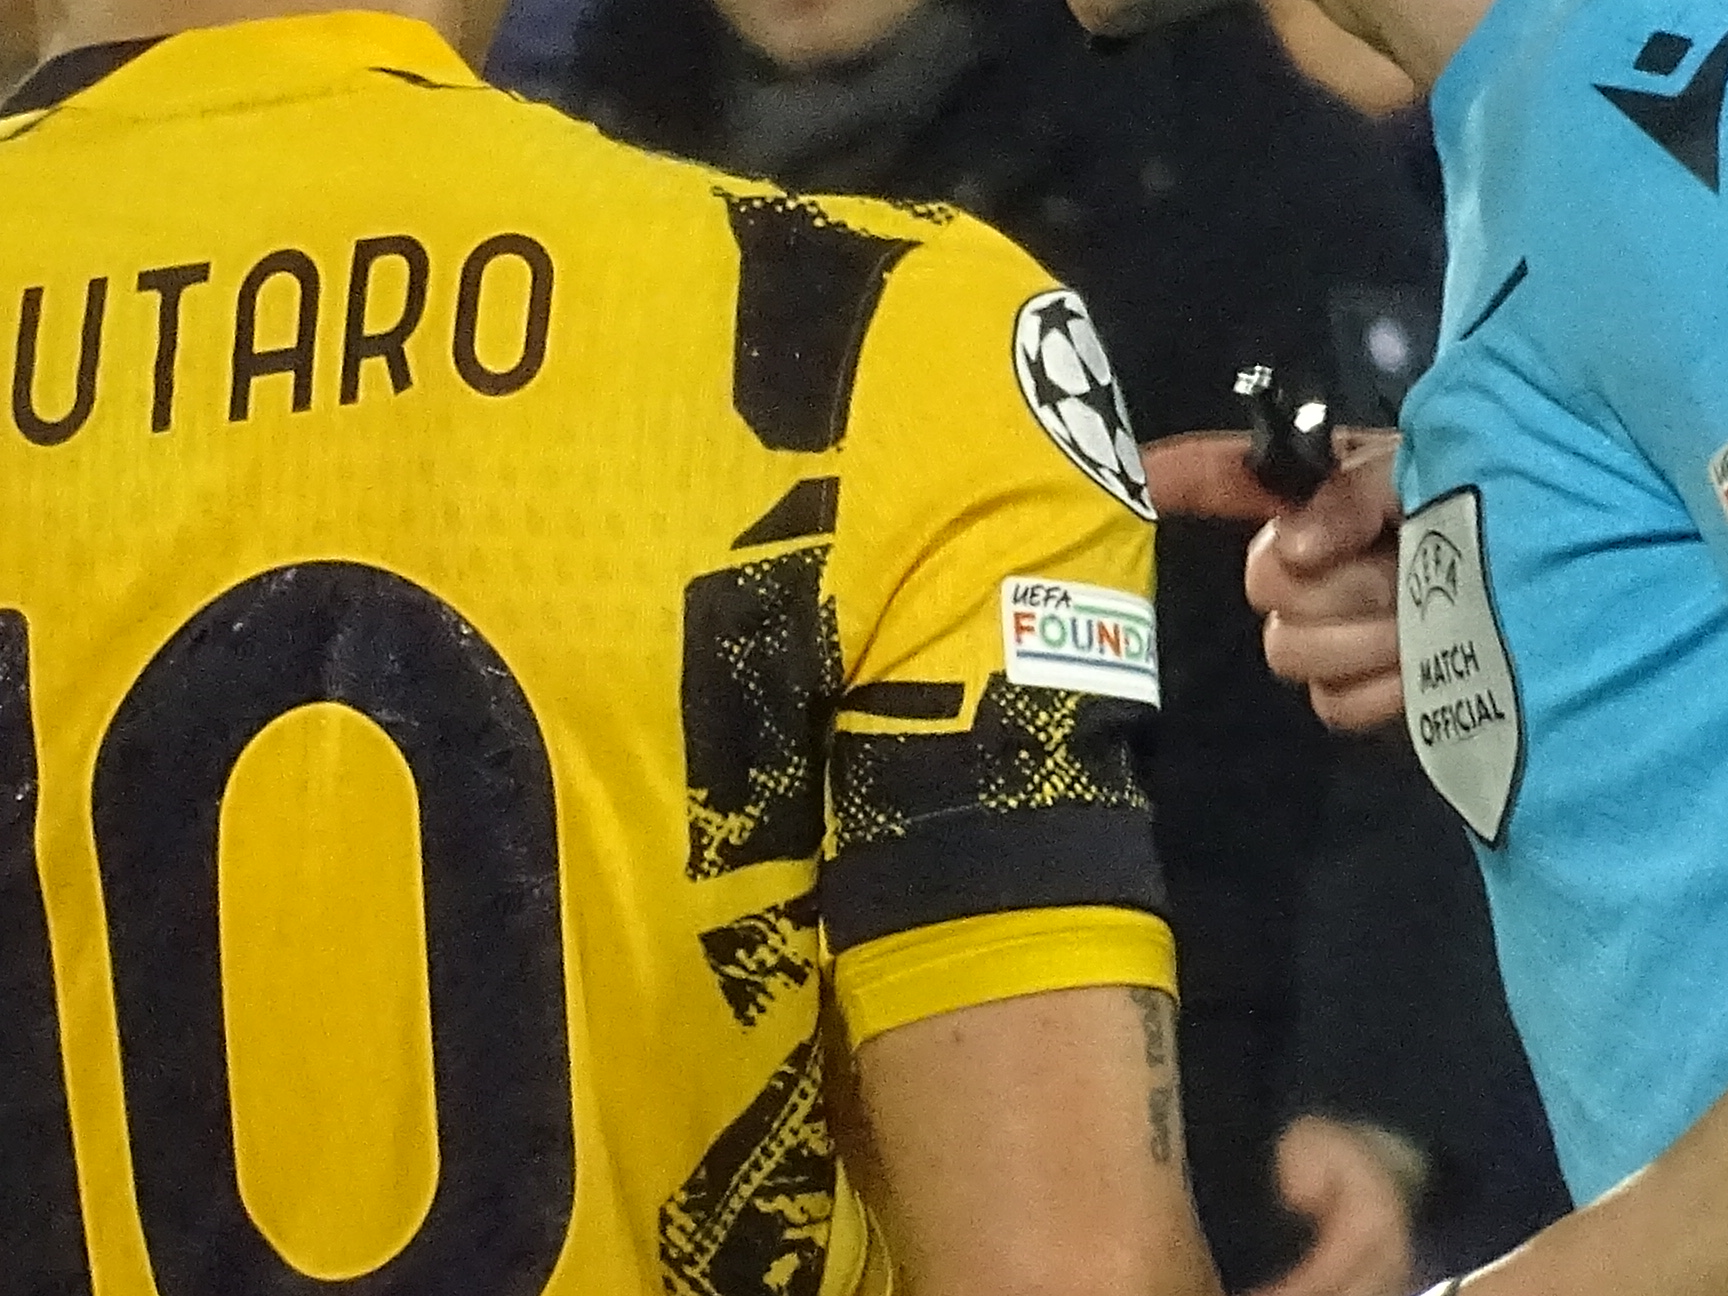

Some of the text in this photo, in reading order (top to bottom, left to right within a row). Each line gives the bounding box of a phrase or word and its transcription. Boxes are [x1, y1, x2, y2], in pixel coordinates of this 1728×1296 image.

[1012, 583, 1072, 608] UEFA
[1419, 640, 1480, 693] MATCH
[1420, 689, 1506, 747] OFFICIAL
